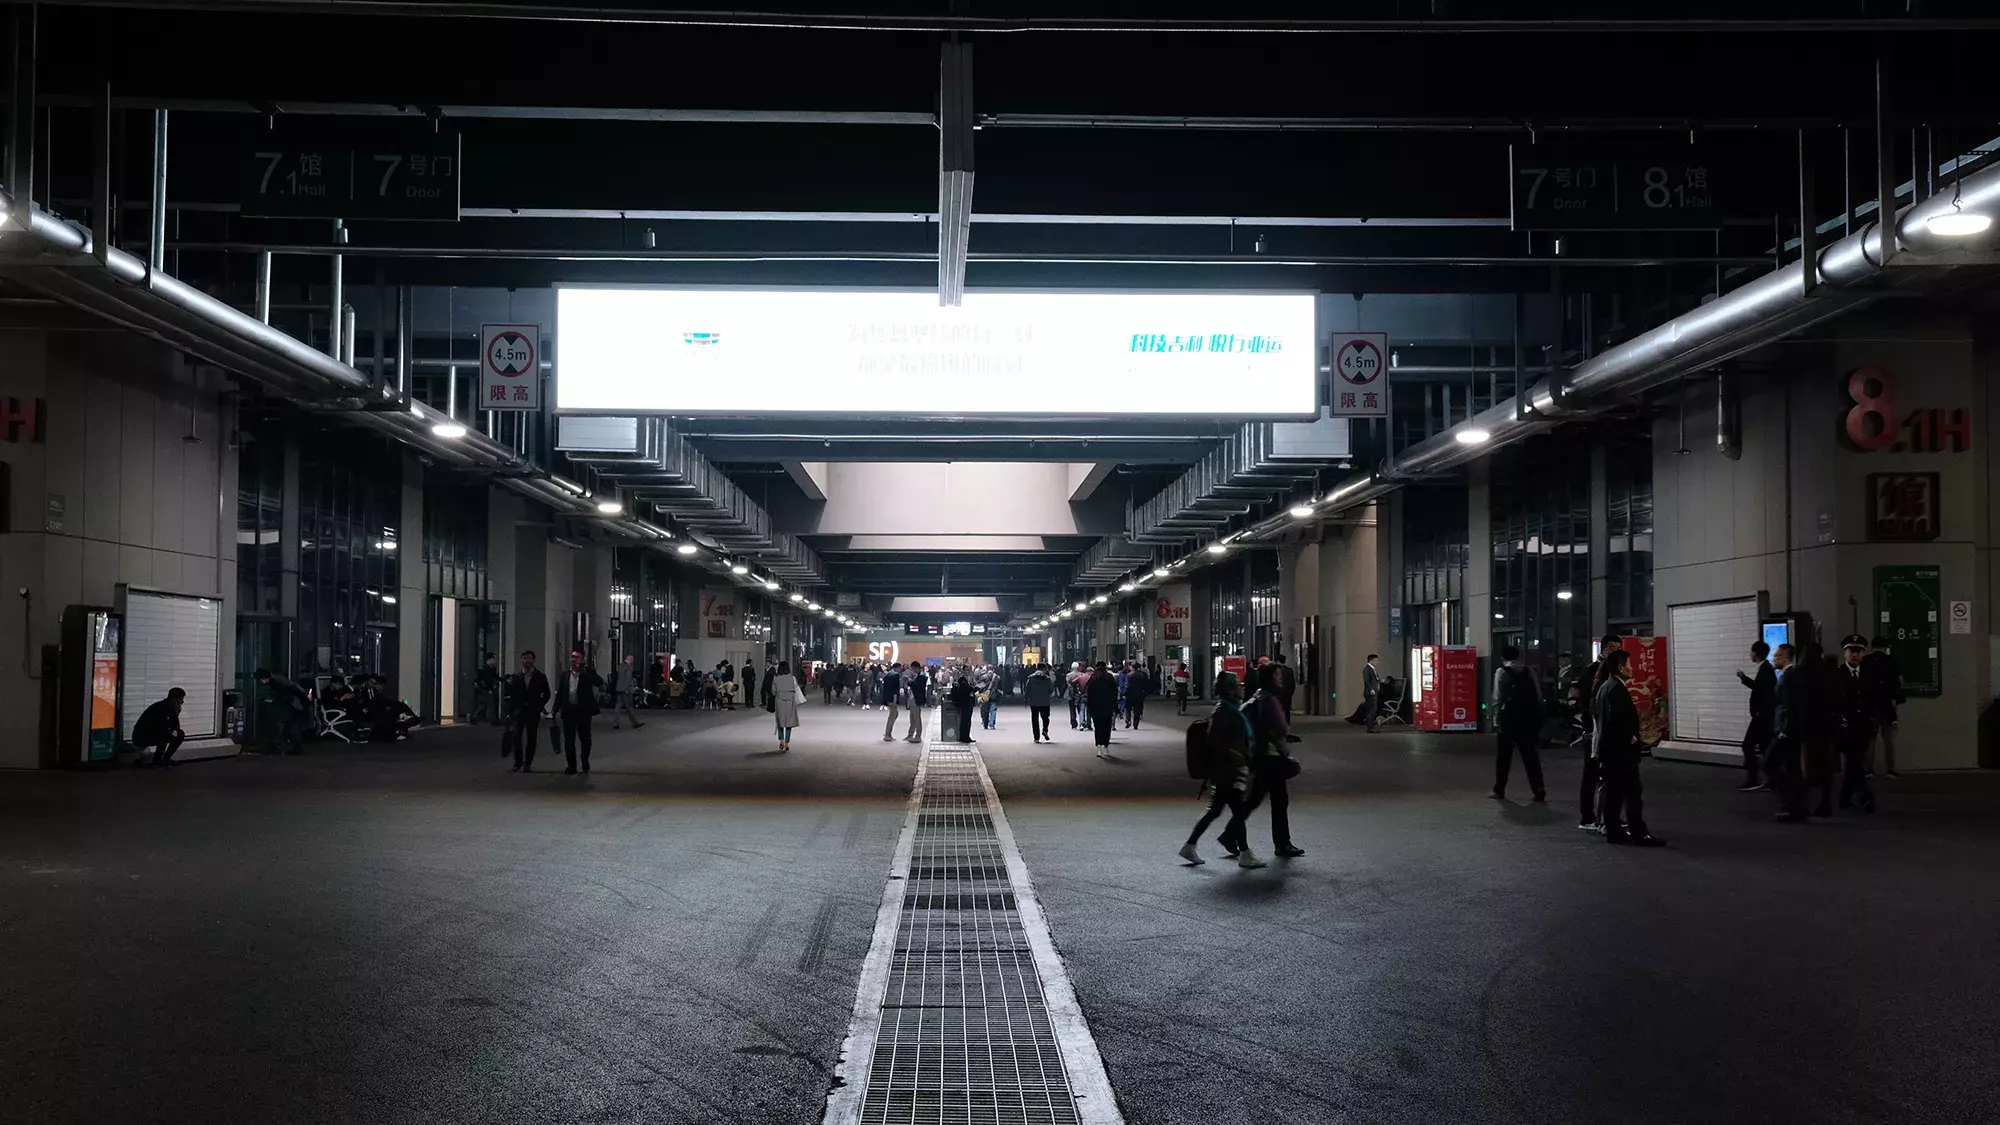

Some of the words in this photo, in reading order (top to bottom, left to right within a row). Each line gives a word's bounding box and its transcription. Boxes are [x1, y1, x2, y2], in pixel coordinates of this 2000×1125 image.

[299, 153, 322, 176] 馆
[373, 154, 402, 196] 7
[407, 155, 452, 176] 号门
[1685, 166, 1708, 189] 馆
[299, 183, 326, 196] Hall
[406, 186, 443, 198] Door
[1520, 168, 1548, 209] 7
[1552, 168, 1597, 188] 号门
[1554, 197, 1588, 209] Door
[1686, 195, 1712, 207] Hall
[494, 348, 527, 360] 4.5m
[1344, 357, 1375, 368] 4.5m
[491, 385, 529, 401] 限高
[1341, 392, 1378, 408] 限高
[1845, 367, 1971, 451] 8.1H
[1157, 597, 1189, 619] 8.1H
